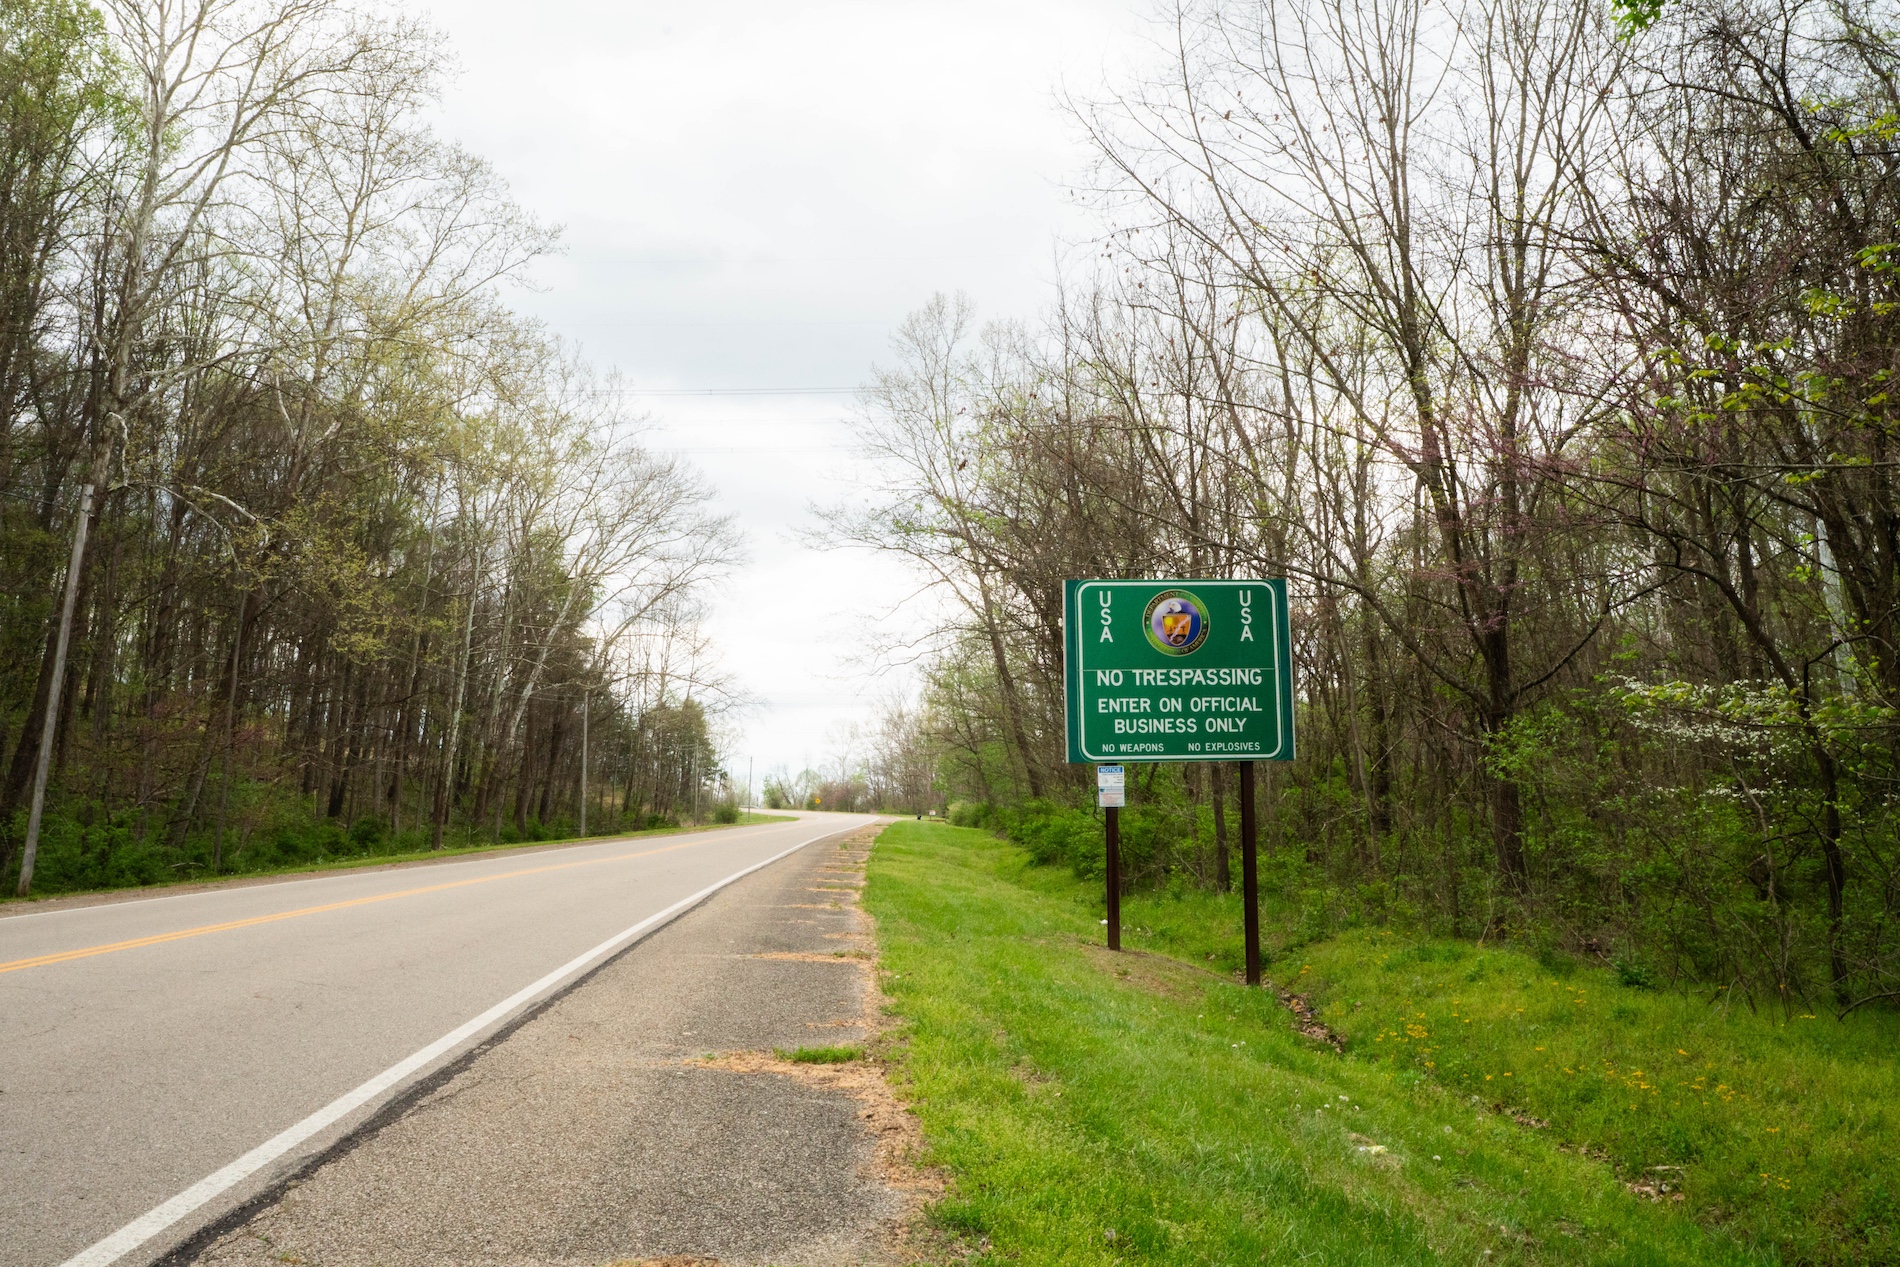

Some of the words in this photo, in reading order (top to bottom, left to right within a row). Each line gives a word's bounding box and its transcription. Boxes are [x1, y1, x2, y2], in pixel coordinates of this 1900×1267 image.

[1099, 591, 1113, 643] USA
[1239, 590, 1253, 642] USA
[1097, 670, 1123, 686] NO
[1132, 669, 1262, 686] TRESPASSING
[1098, 698, 1151, 713] ENTER
[1159, 698, 1182, 713] ON
[1190, 697, 1262, 712] OFFICIAL
[1114, 718, 1197, 734] BUSINESS
[1205, 718, 1247, 733] ONLY
[1102, 743, 1115, 752] NO
[1119, 743, 1164, 752] WEAPONS
[1188, 742, 1201, 752] NO
[1205, 742, 1260, 751] EXPLOSIVES
